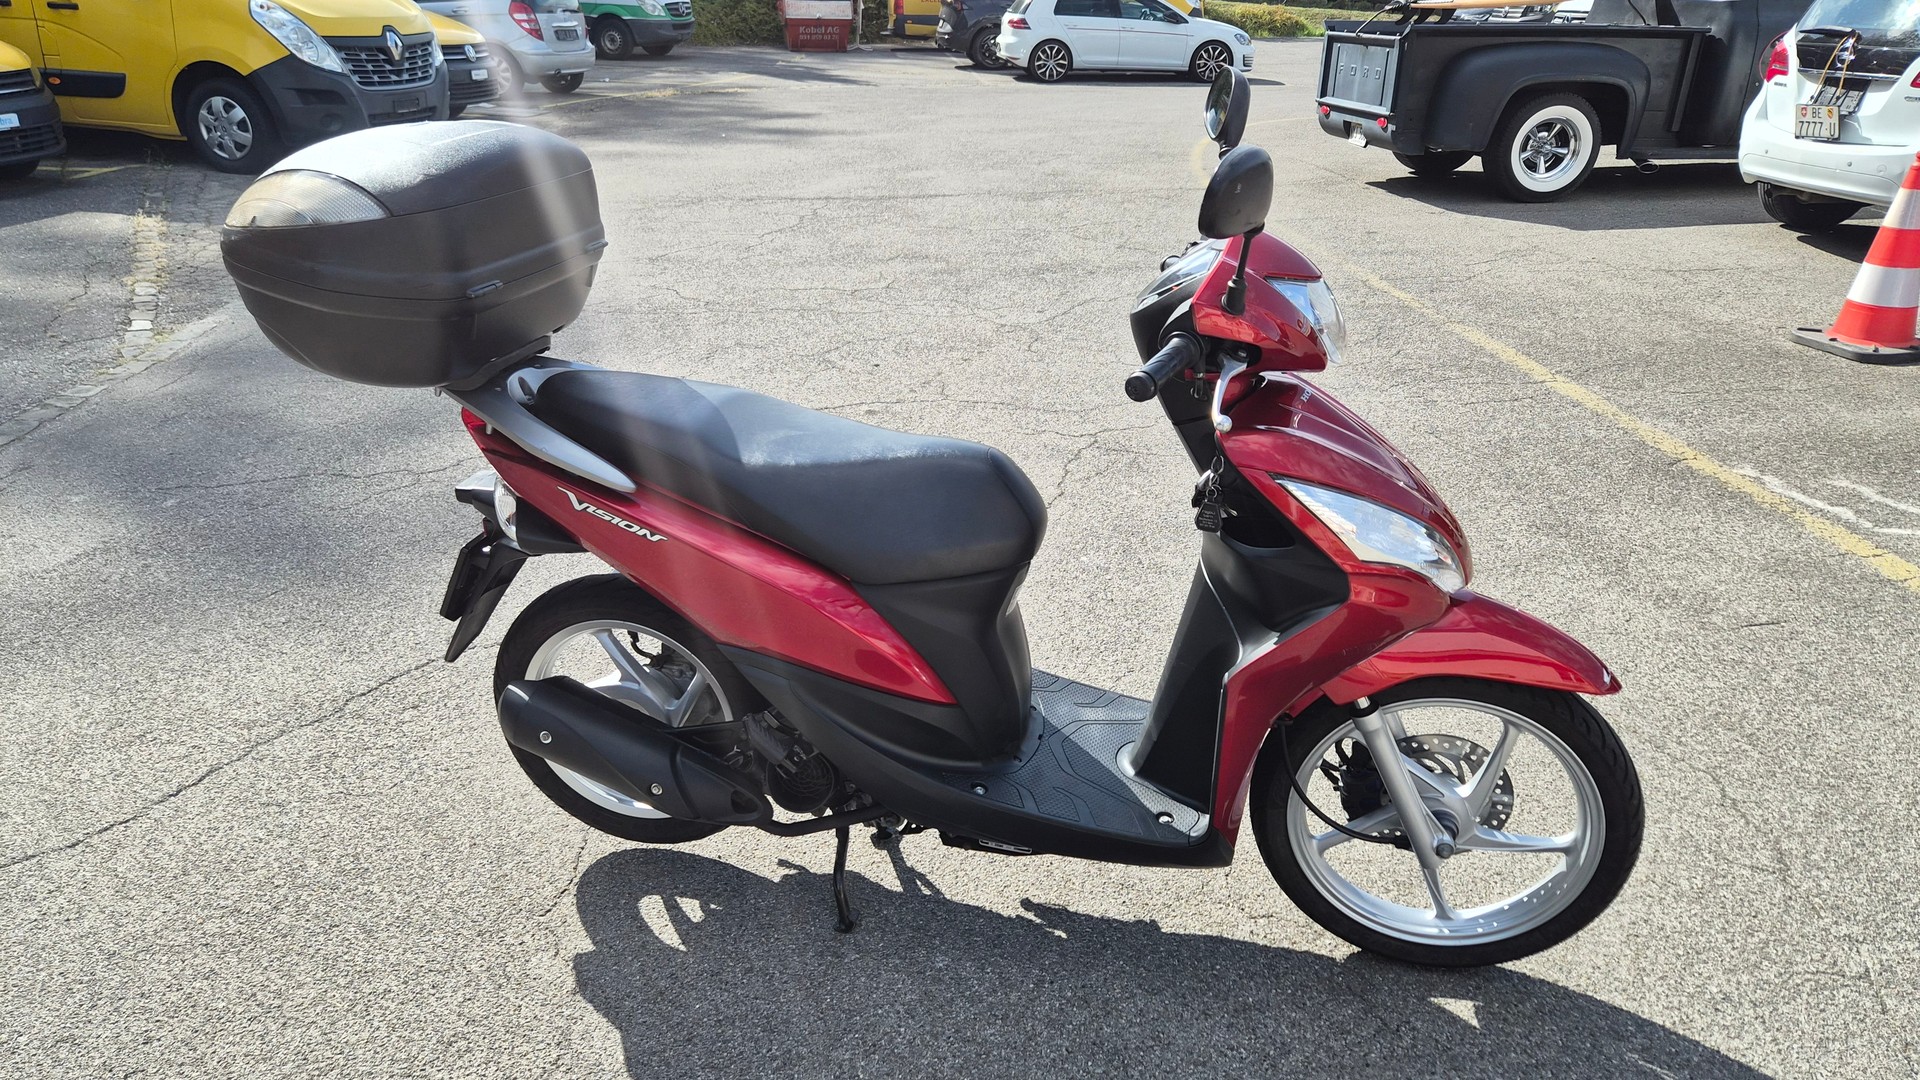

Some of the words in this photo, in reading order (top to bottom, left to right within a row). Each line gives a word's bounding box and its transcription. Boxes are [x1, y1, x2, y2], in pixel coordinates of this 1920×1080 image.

[799, 26, 825, 34] Kobel
[826, 26, 840, 34] AG
[1339, 63, 1381, 80] FORD
[1811, 107, 1823, 119] BE
[557, 486, 668, 542] VISION
